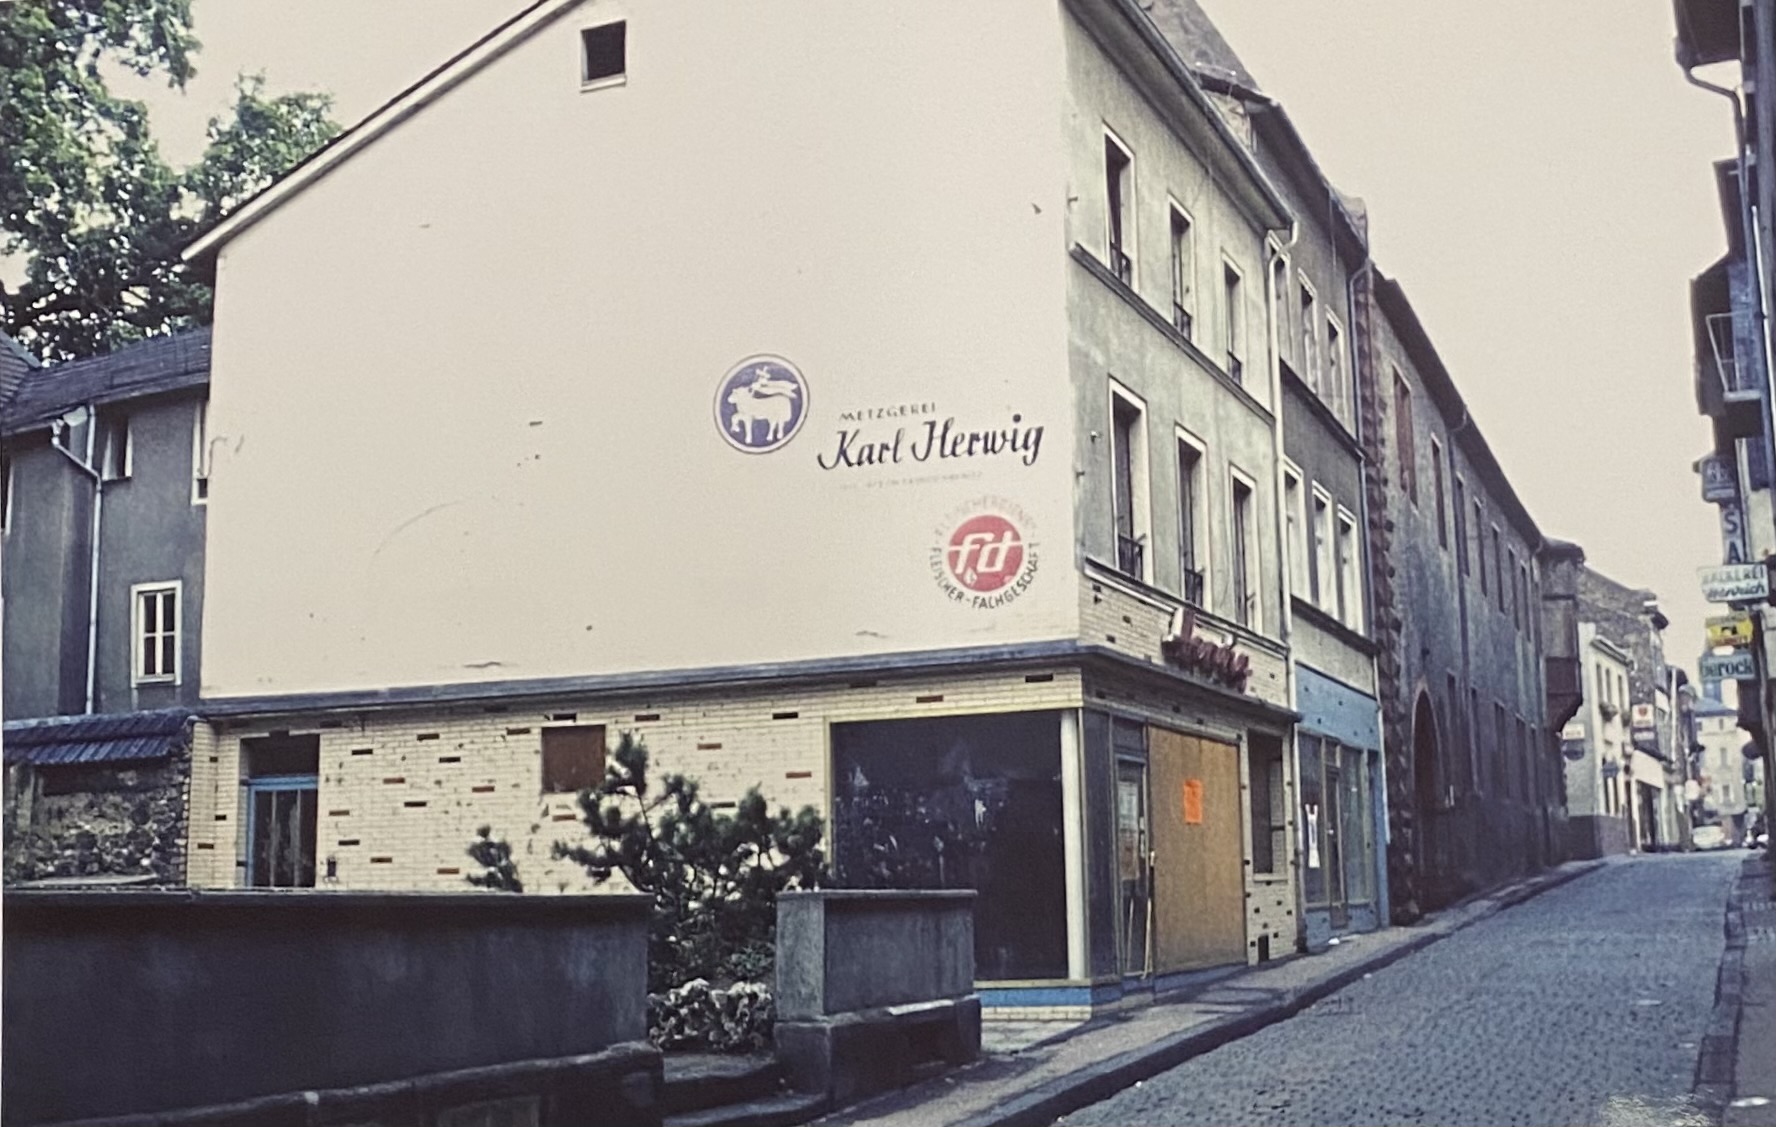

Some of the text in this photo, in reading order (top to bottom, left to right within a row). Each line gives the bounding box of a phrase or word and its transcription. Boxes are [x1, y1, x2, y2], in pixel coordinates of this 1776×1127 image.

[839, 402, 937, 422] METZGEREI
[816, 413, 1045, 471] Karl Herwig
